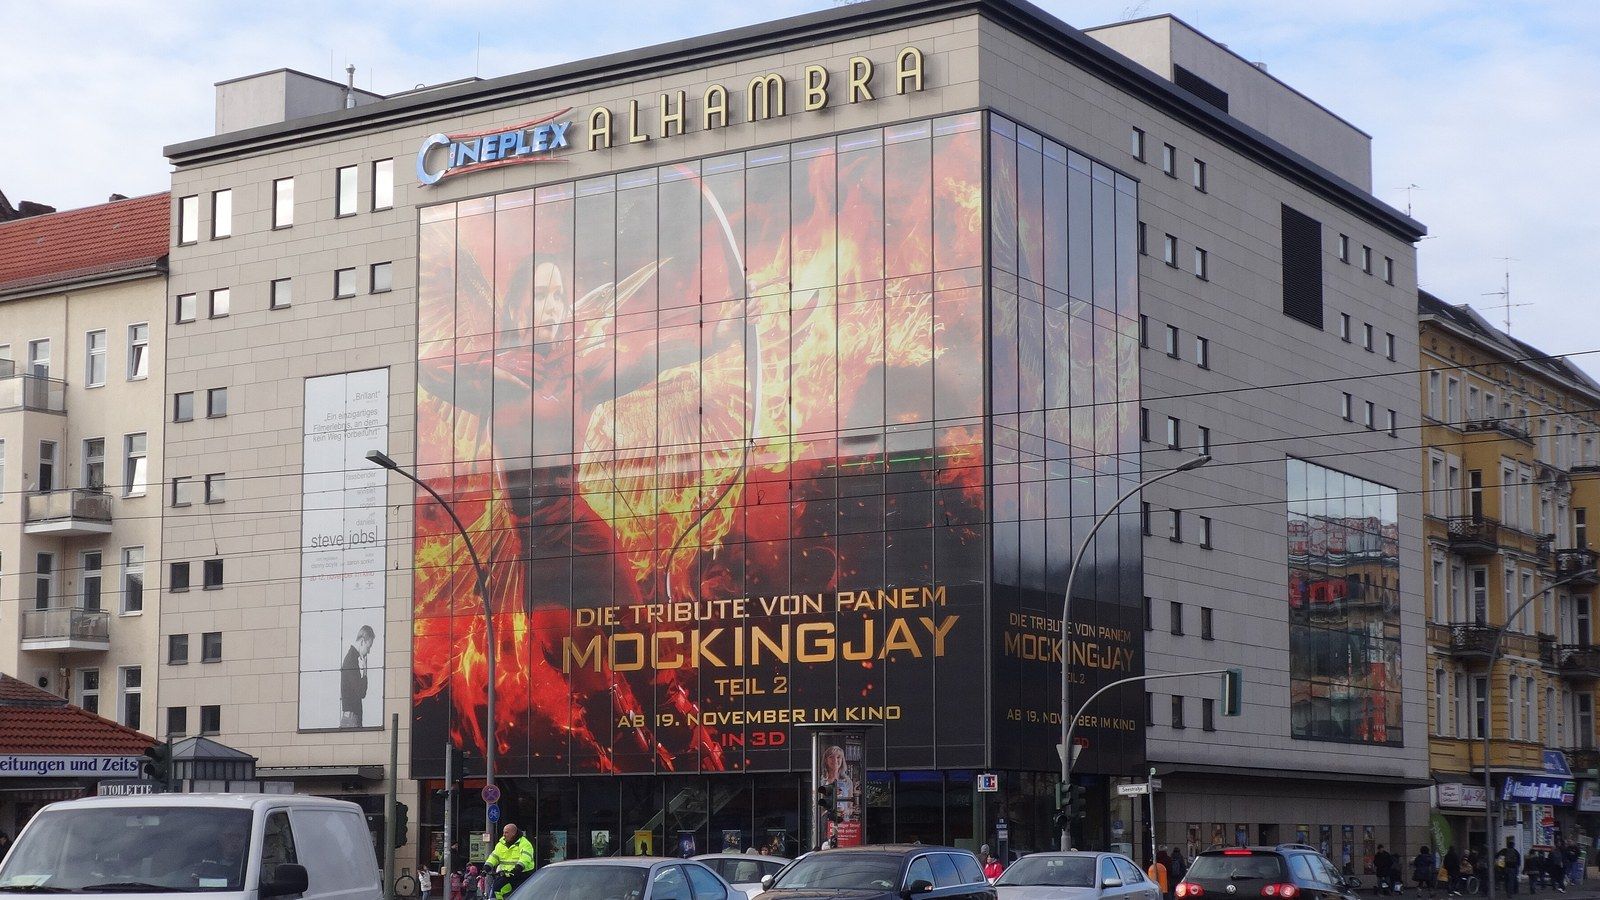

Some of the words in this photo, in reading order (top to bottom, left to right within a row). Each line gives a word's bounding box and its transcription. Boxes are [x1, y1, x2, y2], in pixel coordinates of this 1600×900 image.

[588, 46, 924, 151] ALHAMBRA
[311, 532, 344, 549] steve
[348, 528, 375, 549] jobs
[576, 606, 620, 627] DIE
[633, 598, 750, 624] TRIBUTE
[759, 593, 823, 616] VON
[837, 585, 947, 611] PANEM
[1009, 612, 1028, 628] DIE
[1074, 622, 1096, 637] VON
[1099, 626, 1132, 643] PANEM
[562, 615, 960, 674] MOCKINGJAY
[714, 678, 765, 696] TEIL
[773, 675, 788, 694] 2
[1060, 671, 1078, 684] EIL
[1079, 673, 1086, 684] 2
[617, 714, 645, 729] AB
[656, 712, 680, 727] 19.
[687, 707, 806, 726] NOVEMBER
[814, 708, 838, 722] IM
[845, 706, 901, 720] KINO
[1006, 708, 1022, 721] AB
[1026, 711, 1040, 723] 19.
[1043, 712, 1098, 728] NOVBER
[1101, 717, 1111, 728] IM
[1112, 718, 1136, 731] KINO
[721, 733, 745, 747] IN
[751, 732, 786, 746] 3D
[70, 758, 98, 772] und
[108, 785, 153, 796] TOILETTE
